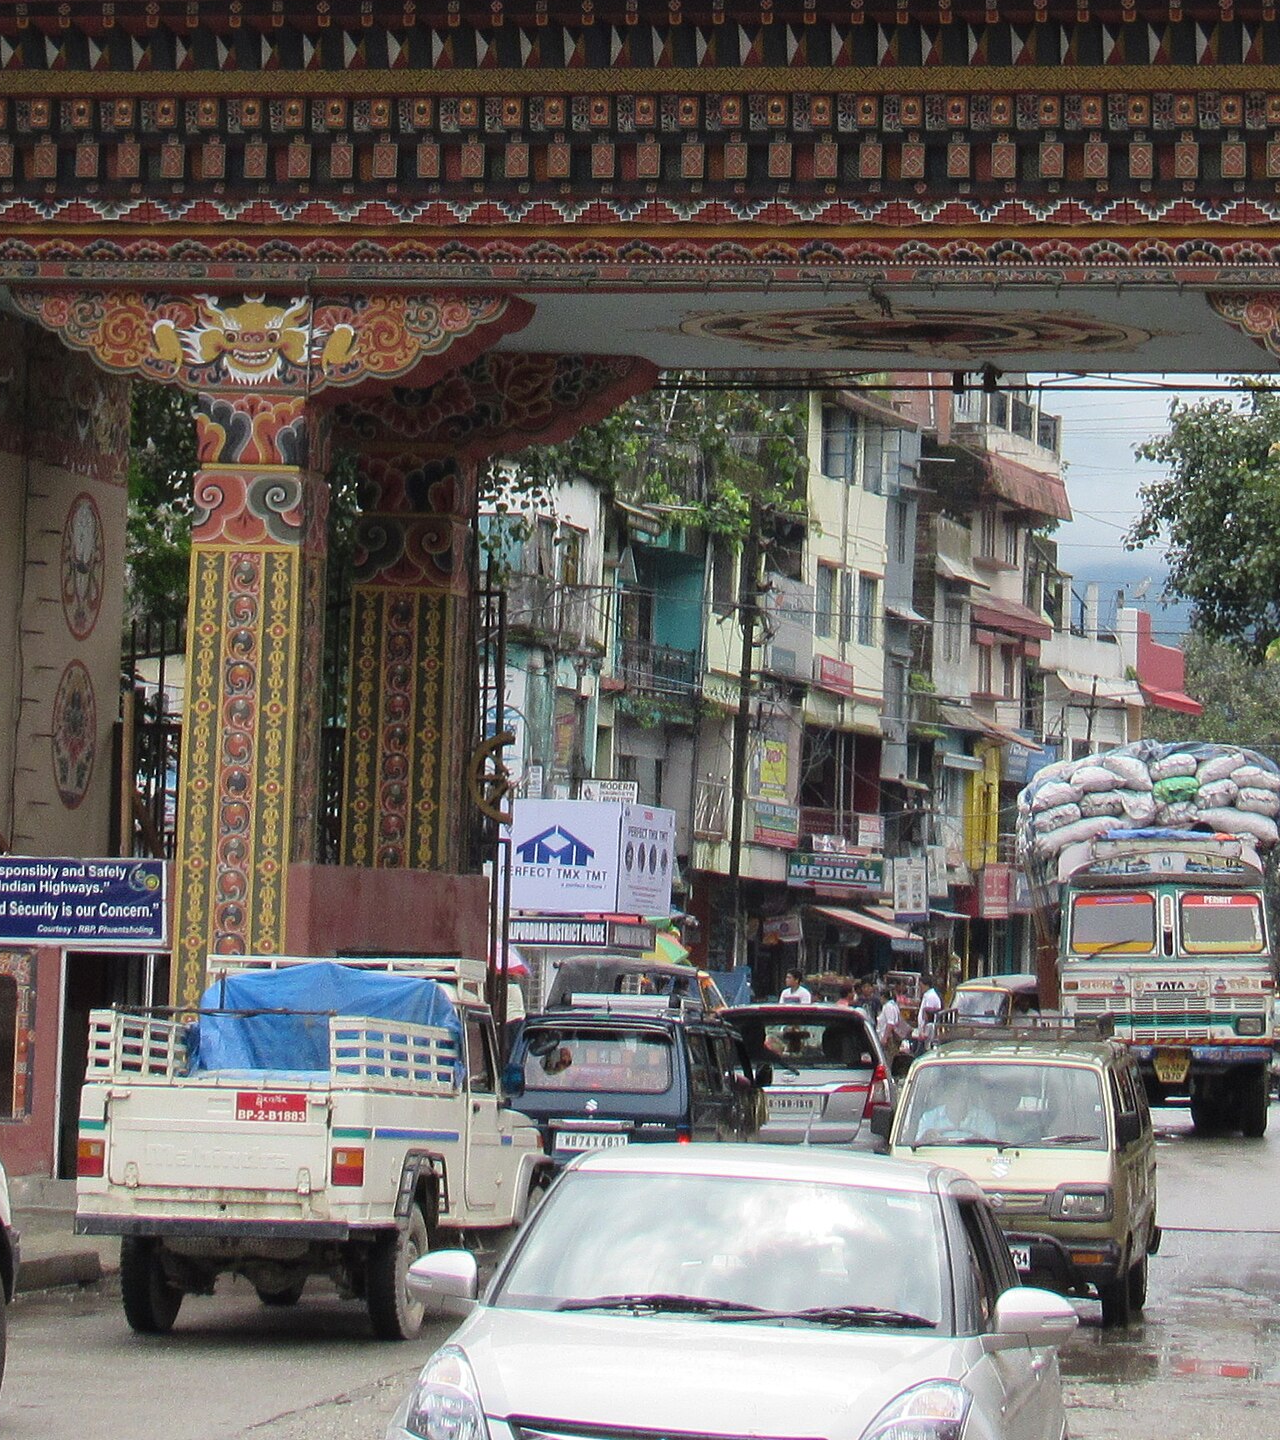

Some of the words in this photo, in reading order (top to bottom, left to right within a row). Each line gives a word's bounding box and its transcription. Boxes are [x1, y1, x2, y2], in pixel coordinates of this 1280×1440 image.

[600, 781, 635, 791] MODERN
[62, 865, 85, 877] and
[88, 865, 127, 880] Safely
[556, 868, 580, 880] TMX
[585, 870, 608, 882] TMT
[790, 864, 880, 882] MEDICAL
[1203, 895, 1233, 905] PERMIT
[9, 900, 59, 920] Security
[61, 902, 73, 916] is
[75, 905, 97, 917] our
[37, 924, 72, 935] Courtesy
[549, 922, 580, 942] DISTRICT
[581, 923, 605, 943] POLICE
[1156, 981, 1185, 990] TATA
